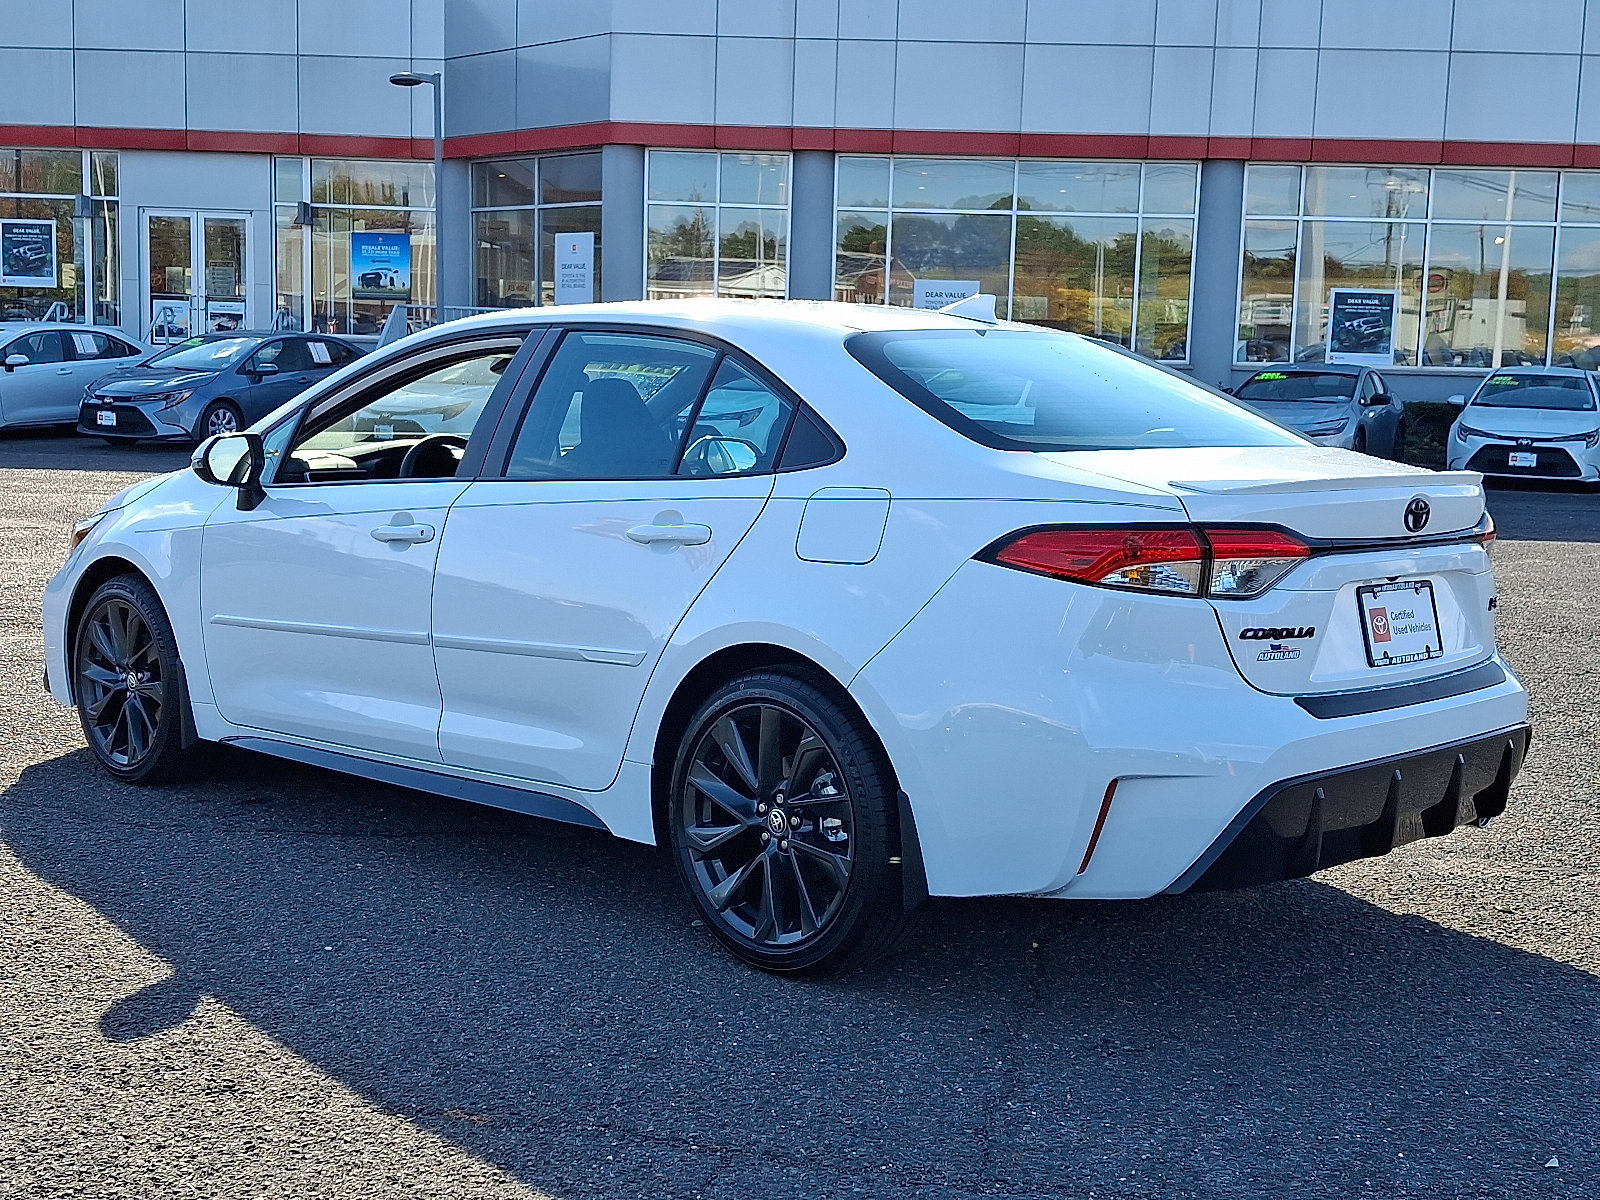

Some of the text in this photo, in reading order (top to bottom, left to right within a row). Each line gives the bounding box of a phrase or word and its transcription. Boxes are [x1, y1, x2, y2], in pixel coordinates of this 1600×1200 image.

[1390, 609, 1415, 621] Certified
[1239, 627, 1316, 640] COROLLA
[1393, 622, 1432, 635] Used Vehicles
[1257, 650, 1300, 661] AUTOLAND
[1391, 653, 1429, 665] AUTOLAND
